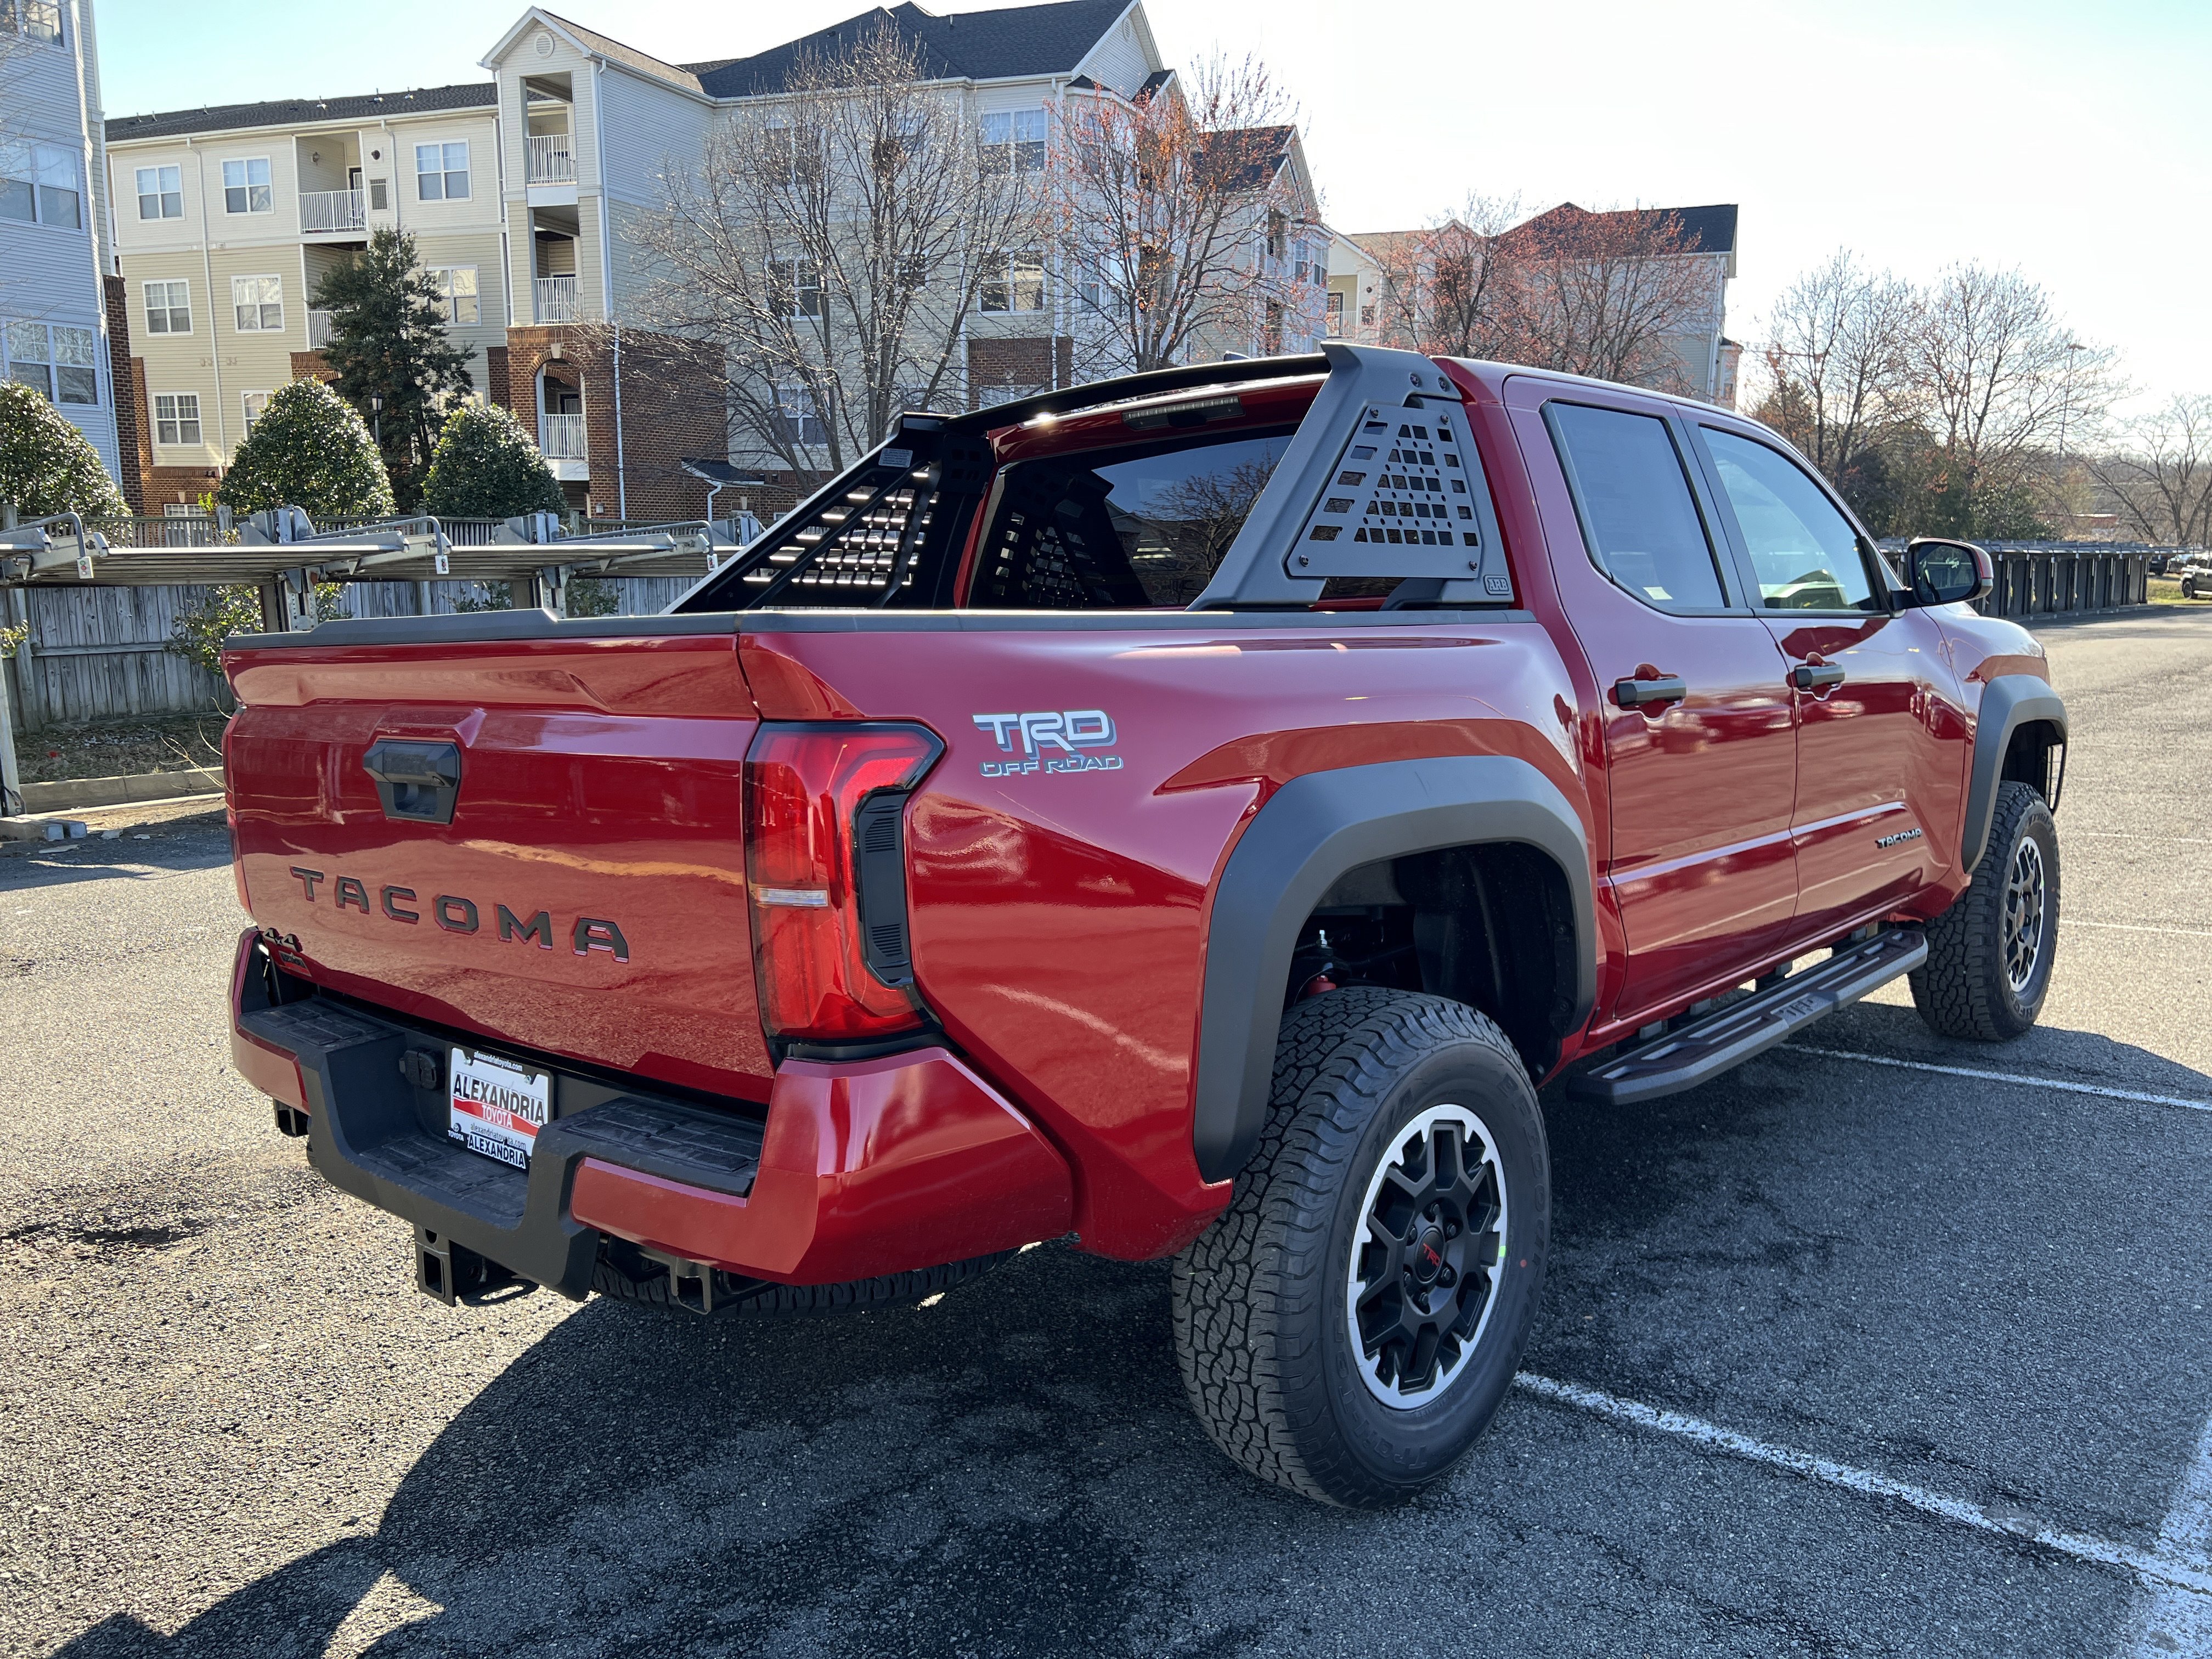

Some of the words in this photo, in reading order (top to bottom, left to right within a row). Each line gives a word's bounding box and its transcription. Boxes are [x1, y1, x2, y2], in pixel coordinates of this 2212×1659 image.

[1487, 578, 1509, 591] ARB
[972, 710, 1117, 758] TRD
[979, 760, 1040, 778] OFF
[1044, 755, 1124, 774] ROAD
[1875, 827, 1922, 849] TACOMA
[290, 866, 629, 963] TACOMA
[263, 927, 302, 952] 4x4
[473, 1050, 523, 1072] alexandriatoyota.com
[453, 1073, 545, 1125] ALEXANDRIA
[482, 1104, 513, 1128] TOYOTA
[448, 1130, 464, 1142] TOYOTA
[470, 1122, 526, 1150] alexandriatoyta.com
[467, 1133, 526, 1170] ALEXANDRIA
[1423, 1243, 1441, 1267] TRD
